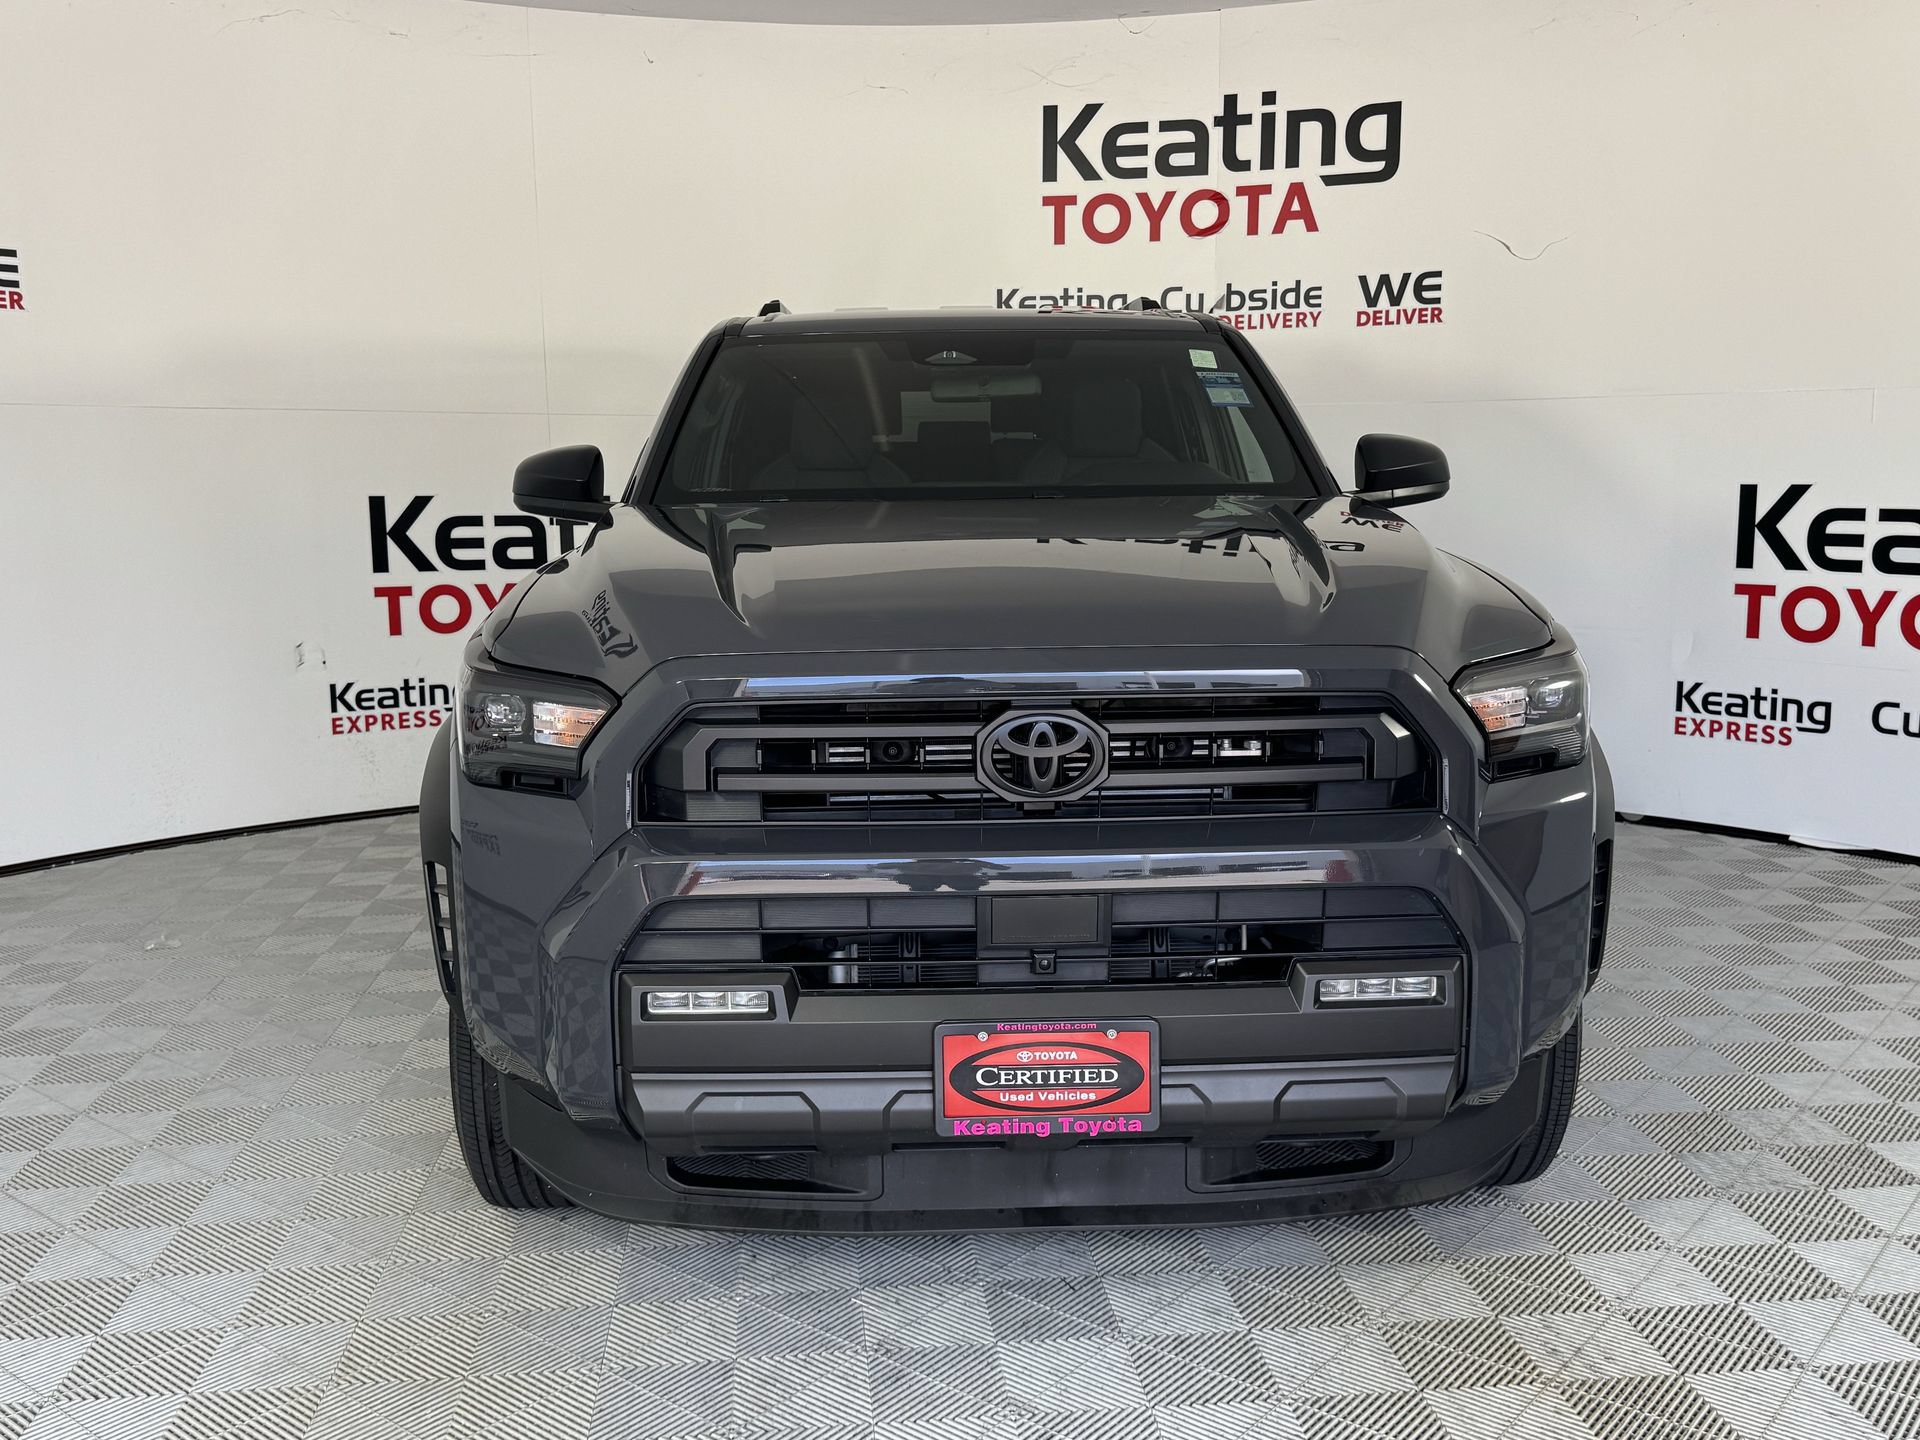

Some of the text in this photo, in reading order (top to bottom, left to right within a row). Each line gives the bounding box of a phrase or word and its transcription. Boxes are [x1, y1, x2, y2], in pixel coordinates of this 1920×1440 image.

[1042, 91, 1402, 186] Keating
[1042, 182, 1319, 245] TOYOTA
[1160, 279, 1323, 314] Cubside
[1358, 270, 1443, 308] WE
[1356, 307, 1443, 327] DELIVER
[329, 677, 457, 714] Keatin
[1675, 681, 1832, 734] Keating
[331, 709, 442, 736] EXPRESS
[1674, 716, 1793, 746] EXPRESS
[1034, 1051, 1078, 1061] TOYOTA
[1000, 1091, 1097, 1102] Used Vehicles
[954, 1117, 1143, 1138] Keating Toyota
